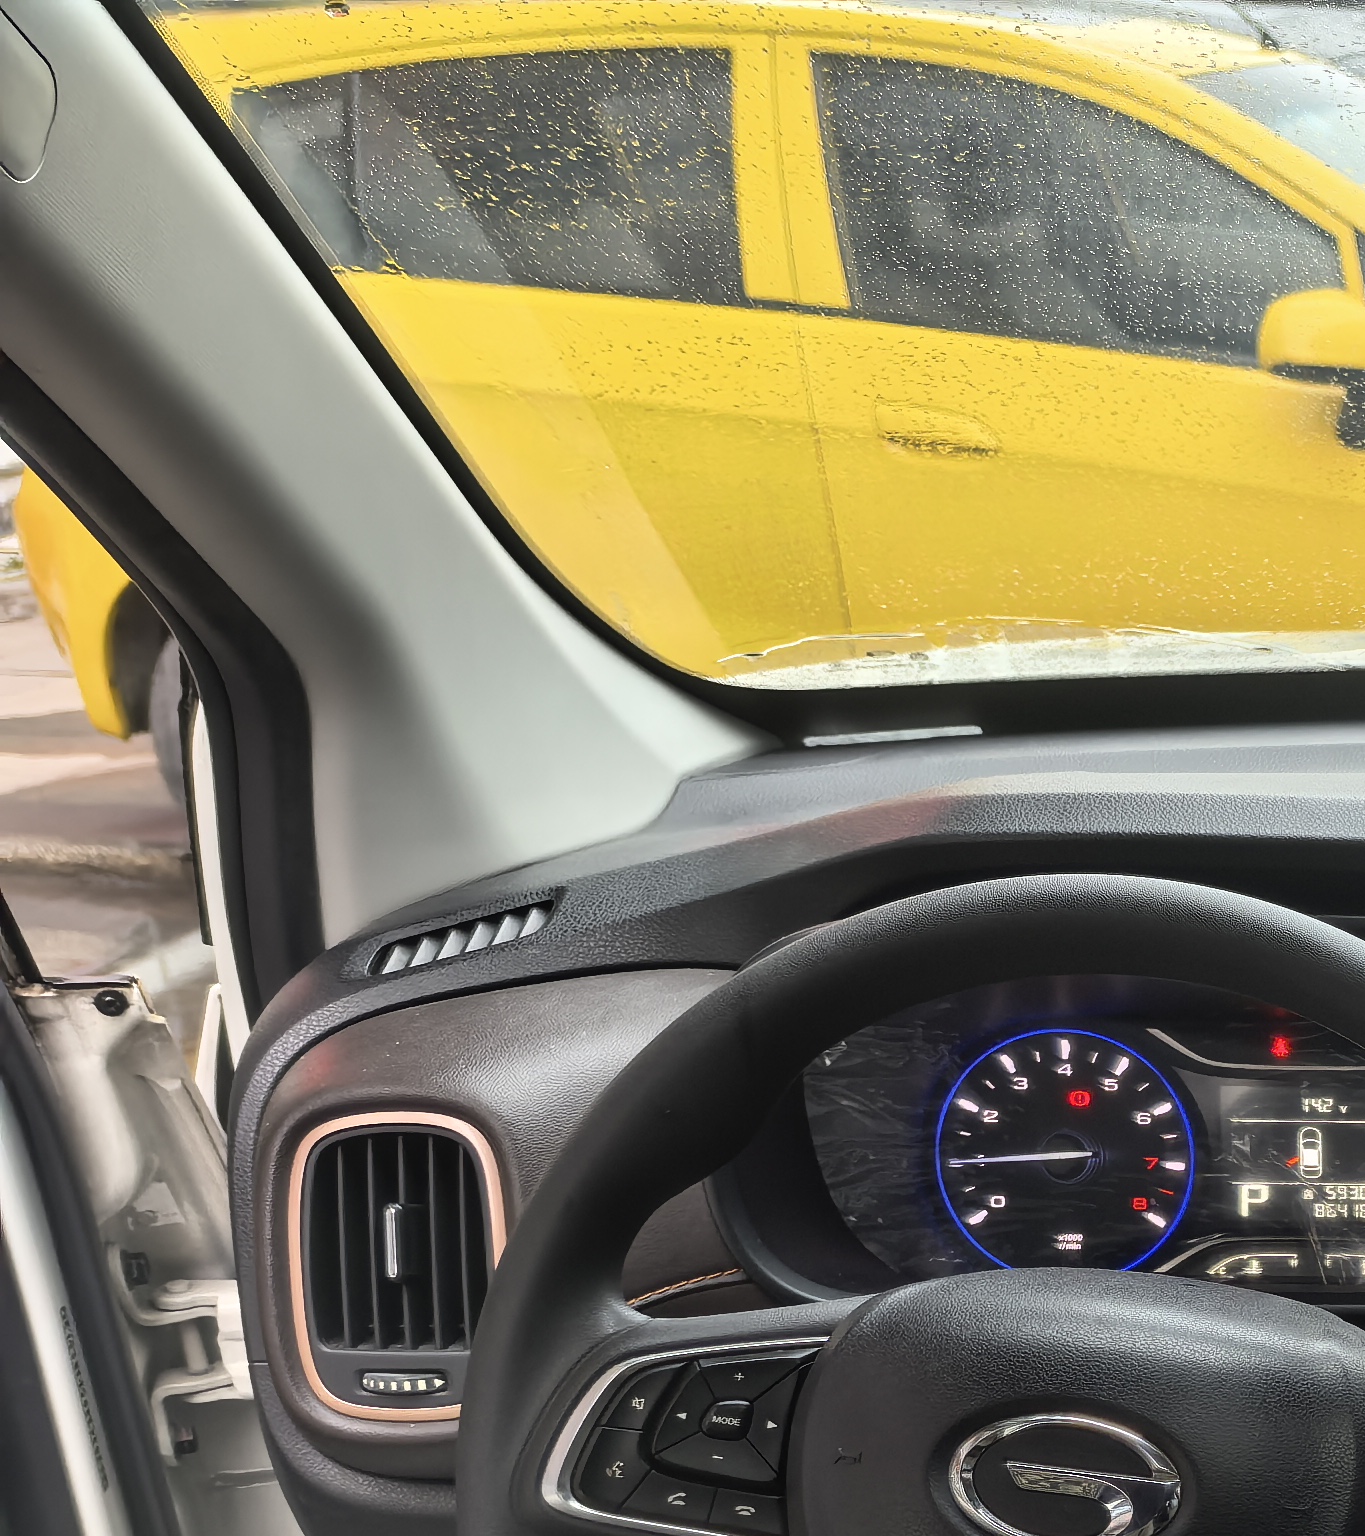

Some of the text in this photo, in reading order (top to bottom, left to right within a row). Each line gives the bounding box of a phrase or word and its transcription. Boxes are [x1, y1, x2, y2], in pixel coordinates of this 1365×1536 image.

[1057, 1064, 1073, 1076] 4
[1014, 1077, 1028, 1090] 3
[1104, 1079, 1118, 1091] 5
[983, 1110, 999, 1123] 2
[1137, 1112, 1151, 1125] 6
[1143, 1157, 1159, 1170] 7
[990, 1195, 1005, 1208] 0
[1132, 1197, 1147, 1210] 8
[1239, 1185, 1269, 1217] P
[712, 1415, 741, 1426] MODE
